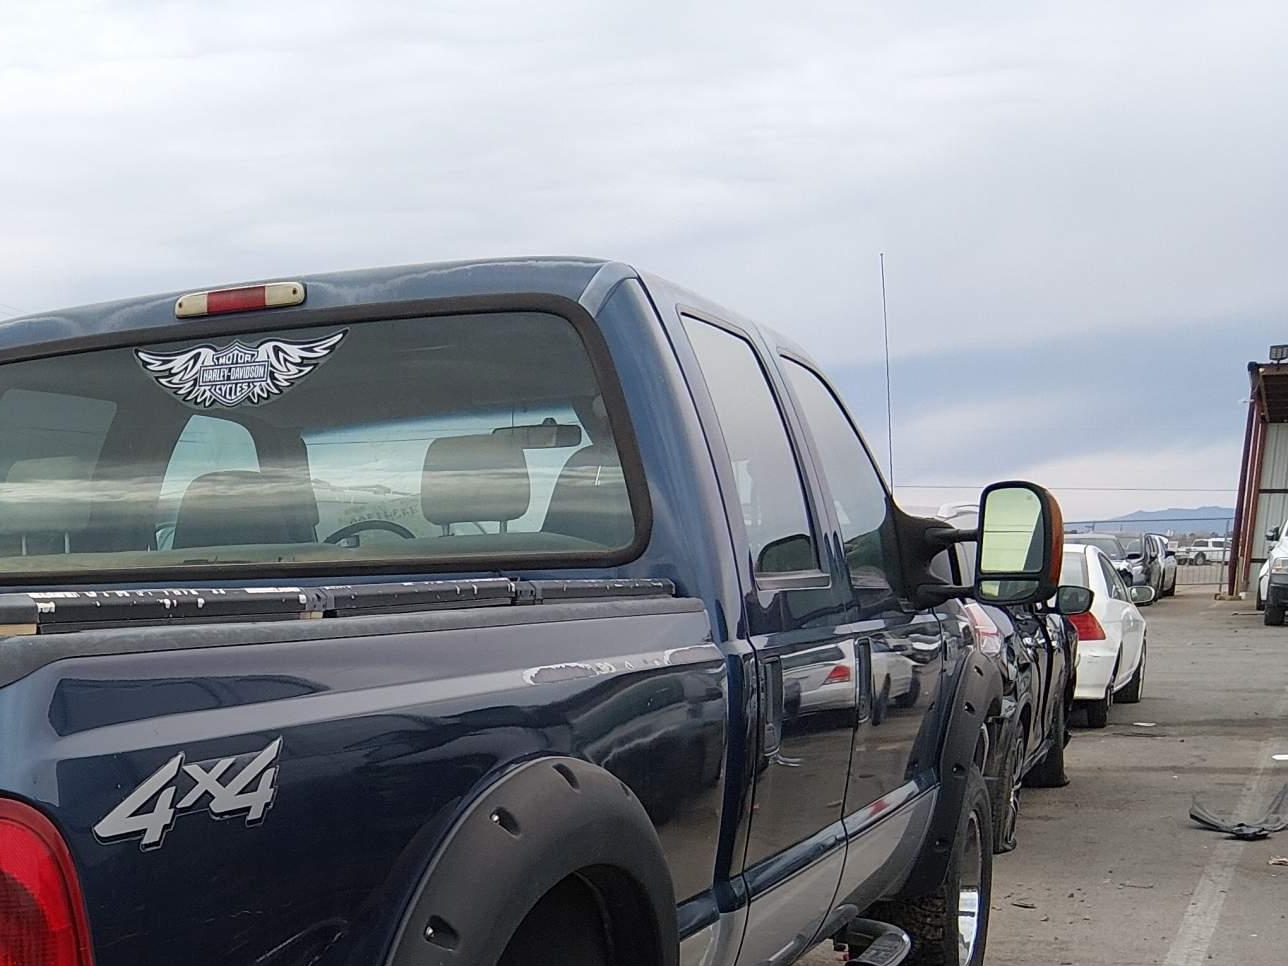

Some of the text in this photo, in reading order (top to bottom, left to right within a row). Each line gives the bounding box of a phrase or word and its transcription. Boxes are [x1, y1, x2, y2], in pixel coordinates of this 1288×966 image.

[218, 350, 252, 365] MOTOR
[202, 365, 265, 382] HARLEY-DAVIDSON
[215, 382, 249, 400] CYCLES
